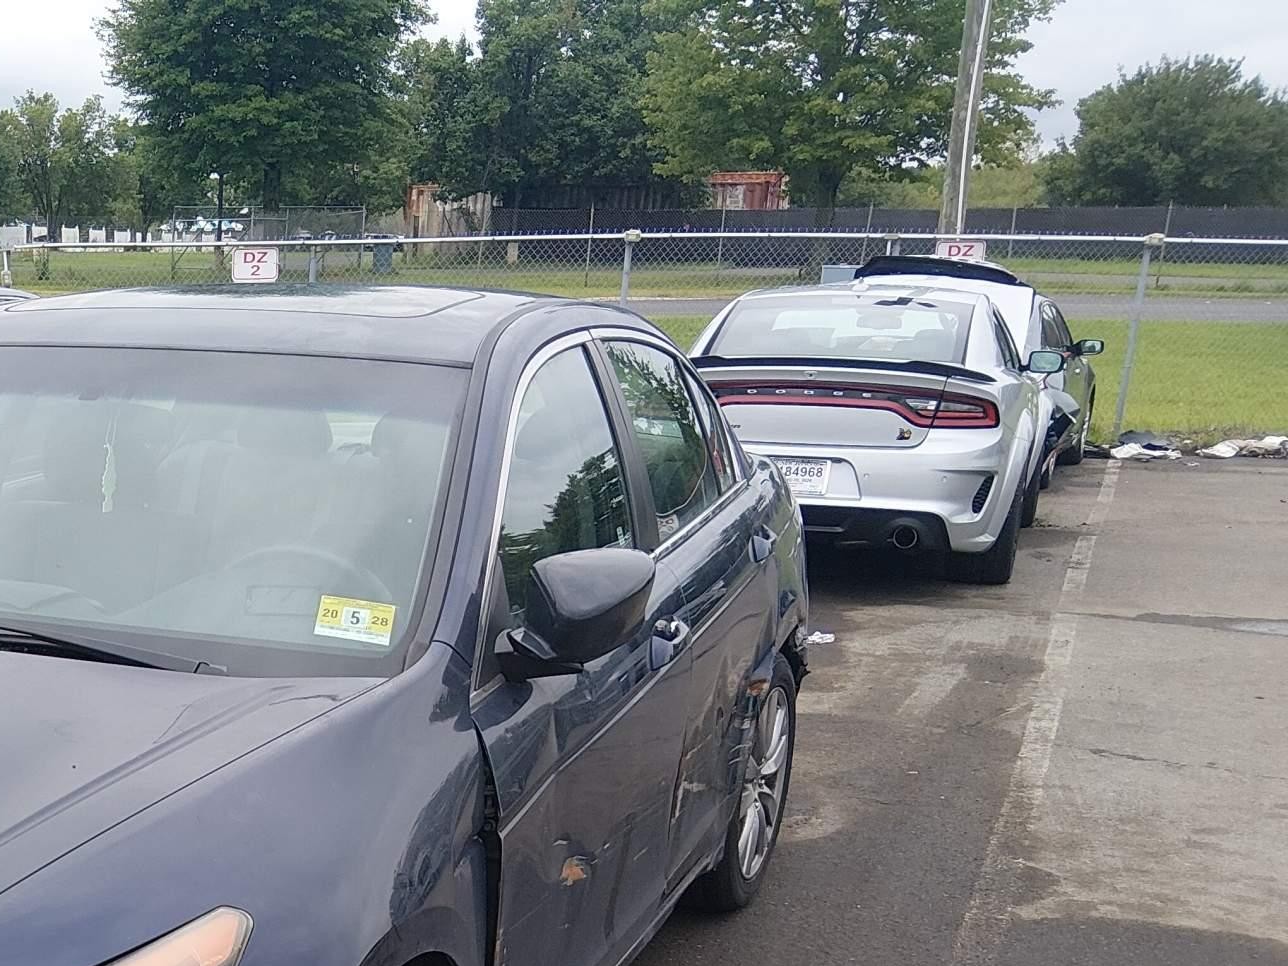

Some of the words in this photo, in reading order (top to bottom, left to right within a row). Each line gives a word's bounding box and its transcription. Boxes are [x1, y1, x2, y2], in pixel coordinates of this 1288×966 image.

[948, 245, 975, 257] DZ
[243, 251, 268, 264] DZ
[251, 264, 261, 276] 2
[322, 608, 338, 619] 20
[350, 611, 361, 625] 5
[371, 615, 389, 627] 28
